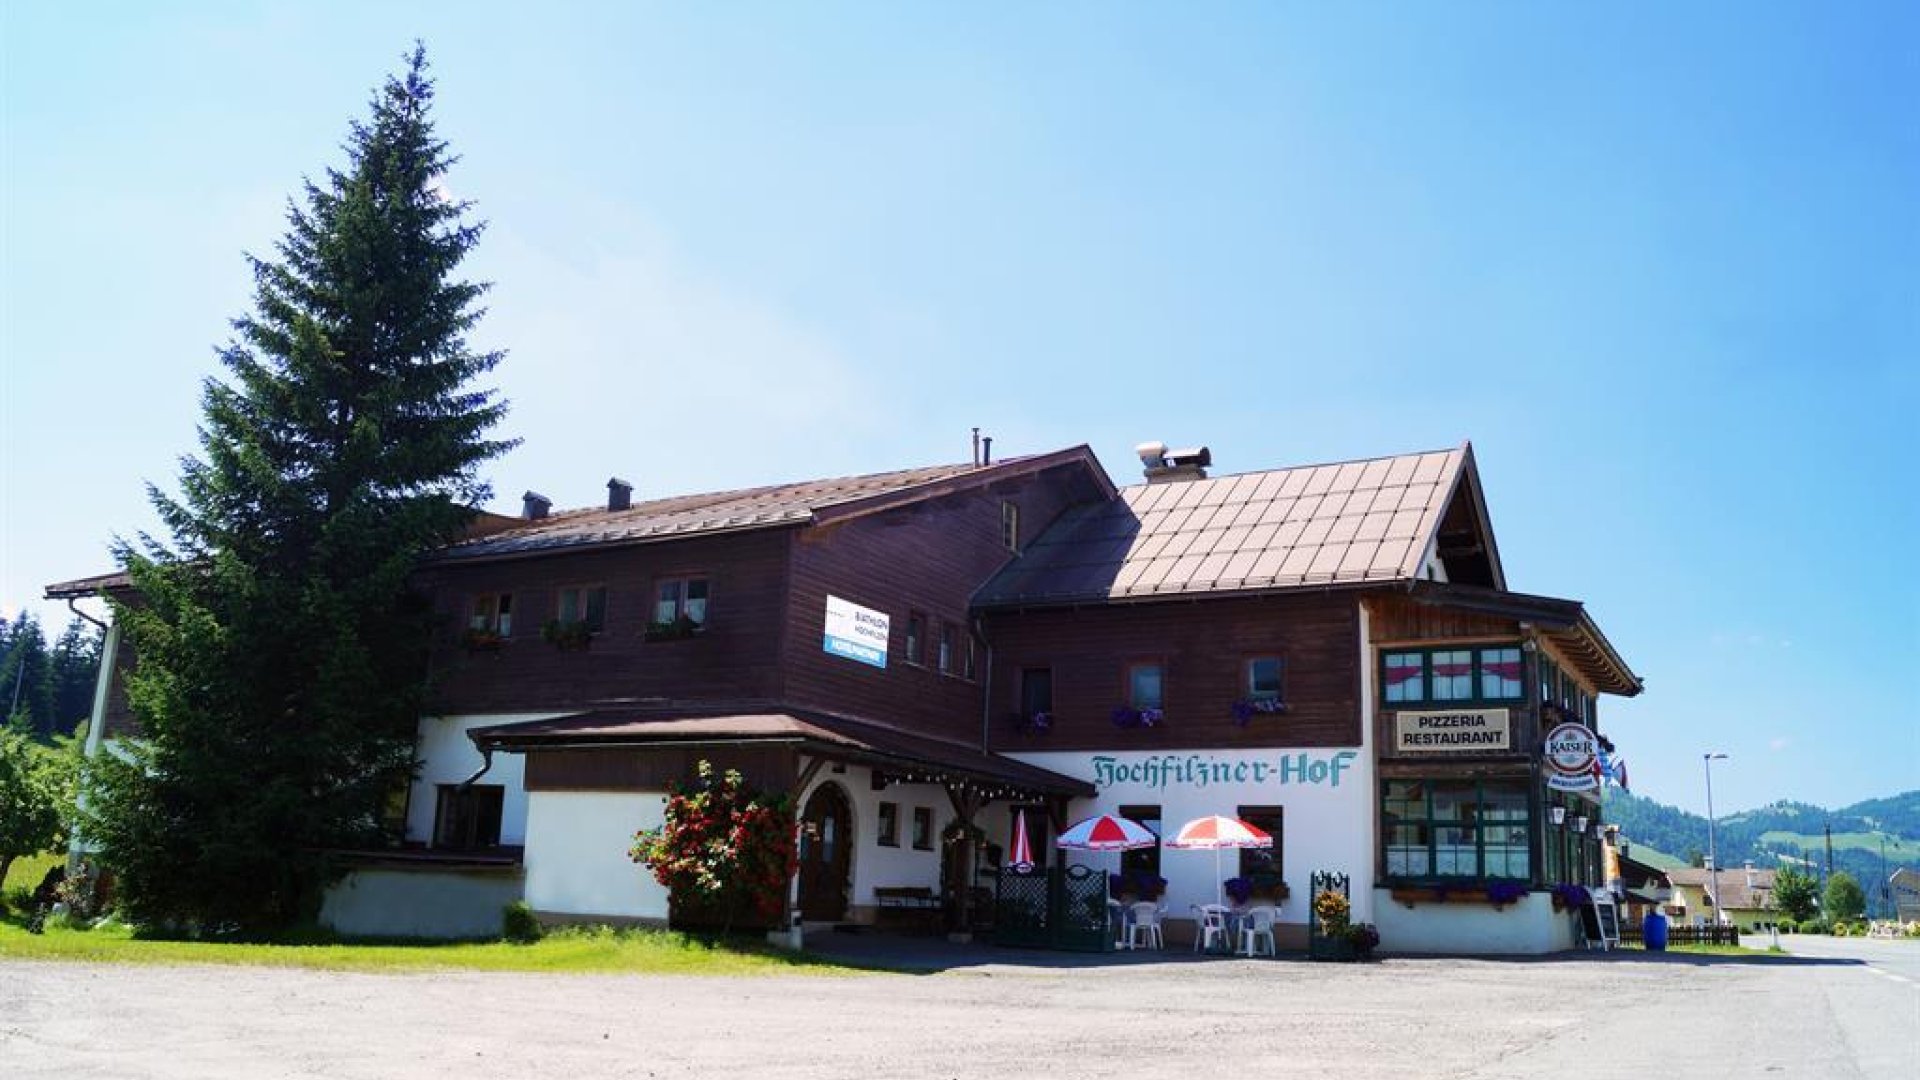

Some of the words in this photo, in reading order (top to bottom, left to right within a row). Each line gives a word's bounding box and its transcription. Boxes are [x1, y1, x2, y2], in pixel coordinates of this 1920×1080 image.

[1419, 715, 1486, 728] PIZZERIA
[1404, 731, 1503, 745] RESTAURANT
[1550, 742, 1593, 753] KAISER
